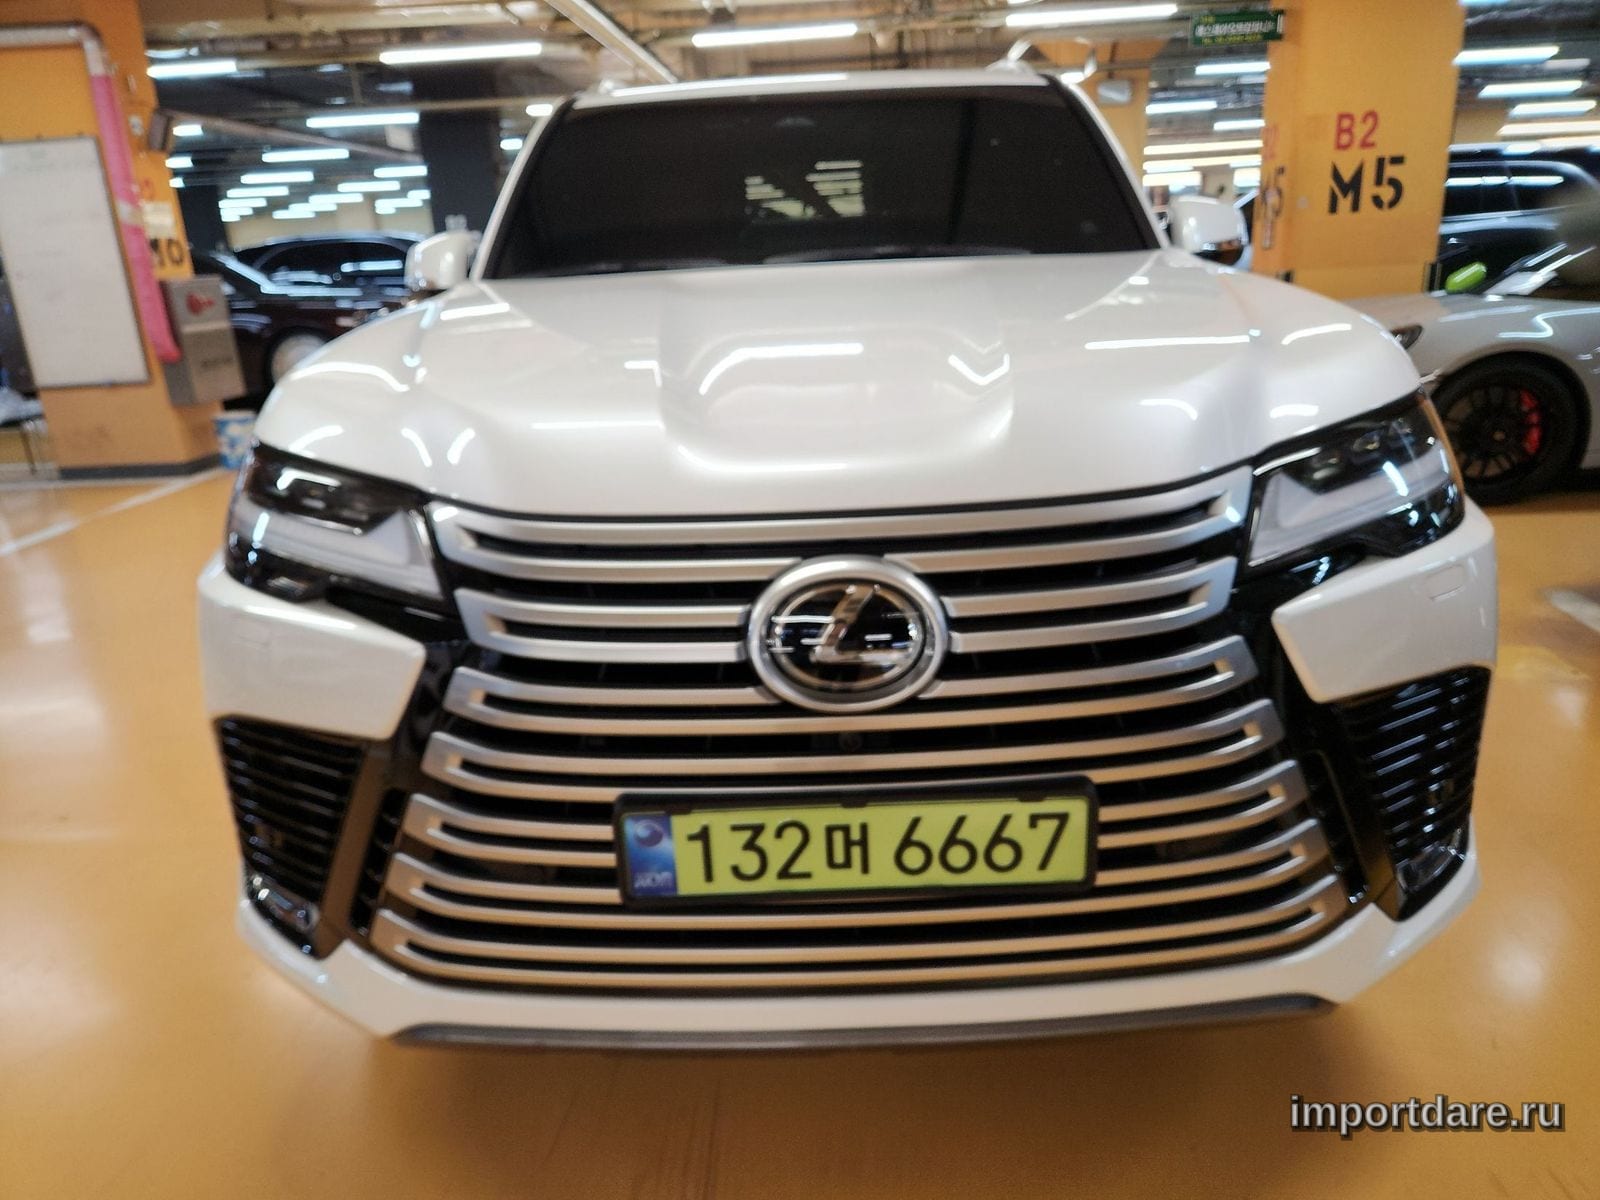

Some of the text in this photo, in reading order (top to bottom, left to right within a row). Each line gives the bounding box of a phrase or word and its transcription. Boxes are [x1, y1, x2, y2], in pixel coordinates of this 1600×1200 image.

[1334, 109, 1379, 151] B2
[1328, 154, 1406, 215] M5
[686, 811, 1070, 883] 132머 6667
